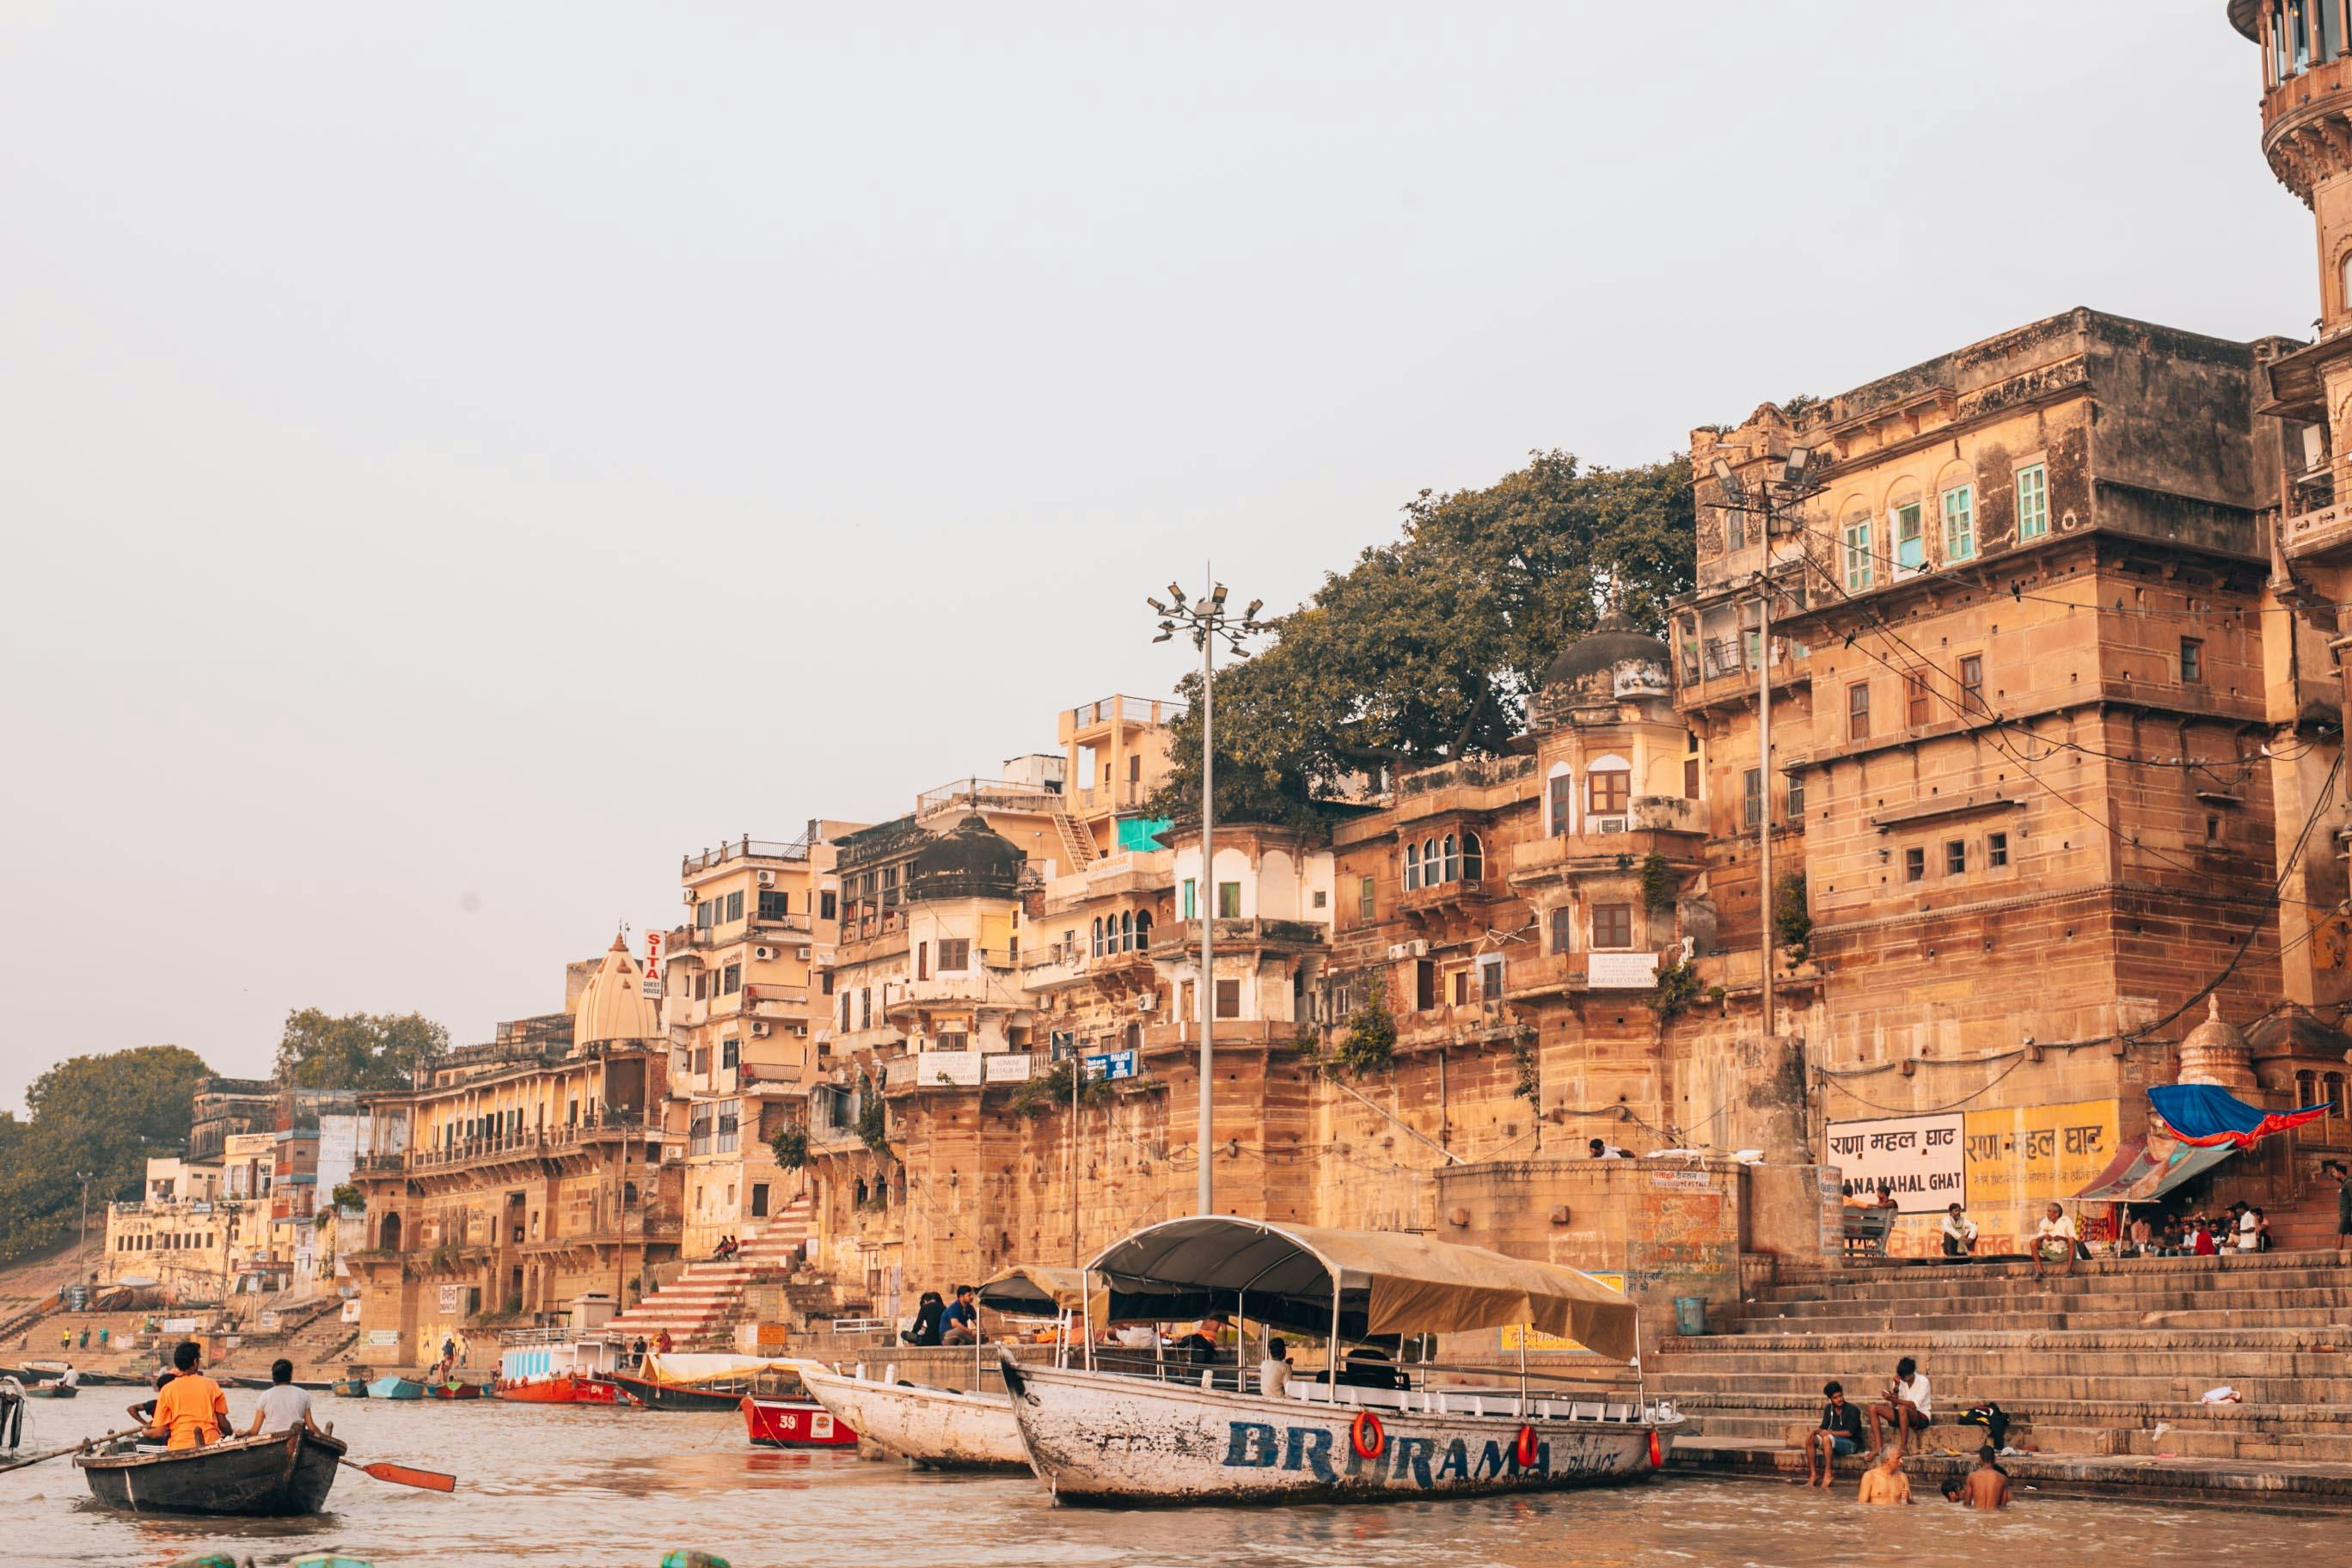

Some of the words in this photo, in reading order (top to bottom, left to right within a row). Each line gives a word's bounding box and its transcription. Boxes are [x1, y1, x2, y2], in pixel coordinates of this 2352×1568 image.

[646, 934, 660, 979] SITA
[1110, 1051, 1130, 1063] PALACE
[1116, 1061, 1125, 1070] ON
[1112, 1069, 1129, 1079] STEPS
[1830, 1134, 1865, 1155] राणा
[1870, 1130, 1918, 1150] महल
[1926, 1128, 1957, 1147] घाट
[2064, 1125, 2104, 1155] घाट
[1929, 1172, 1963, 1190] GHAT
[779, 1414, 796, 1430] 39
[1568, 1451, 1622, 1473] PALACE
